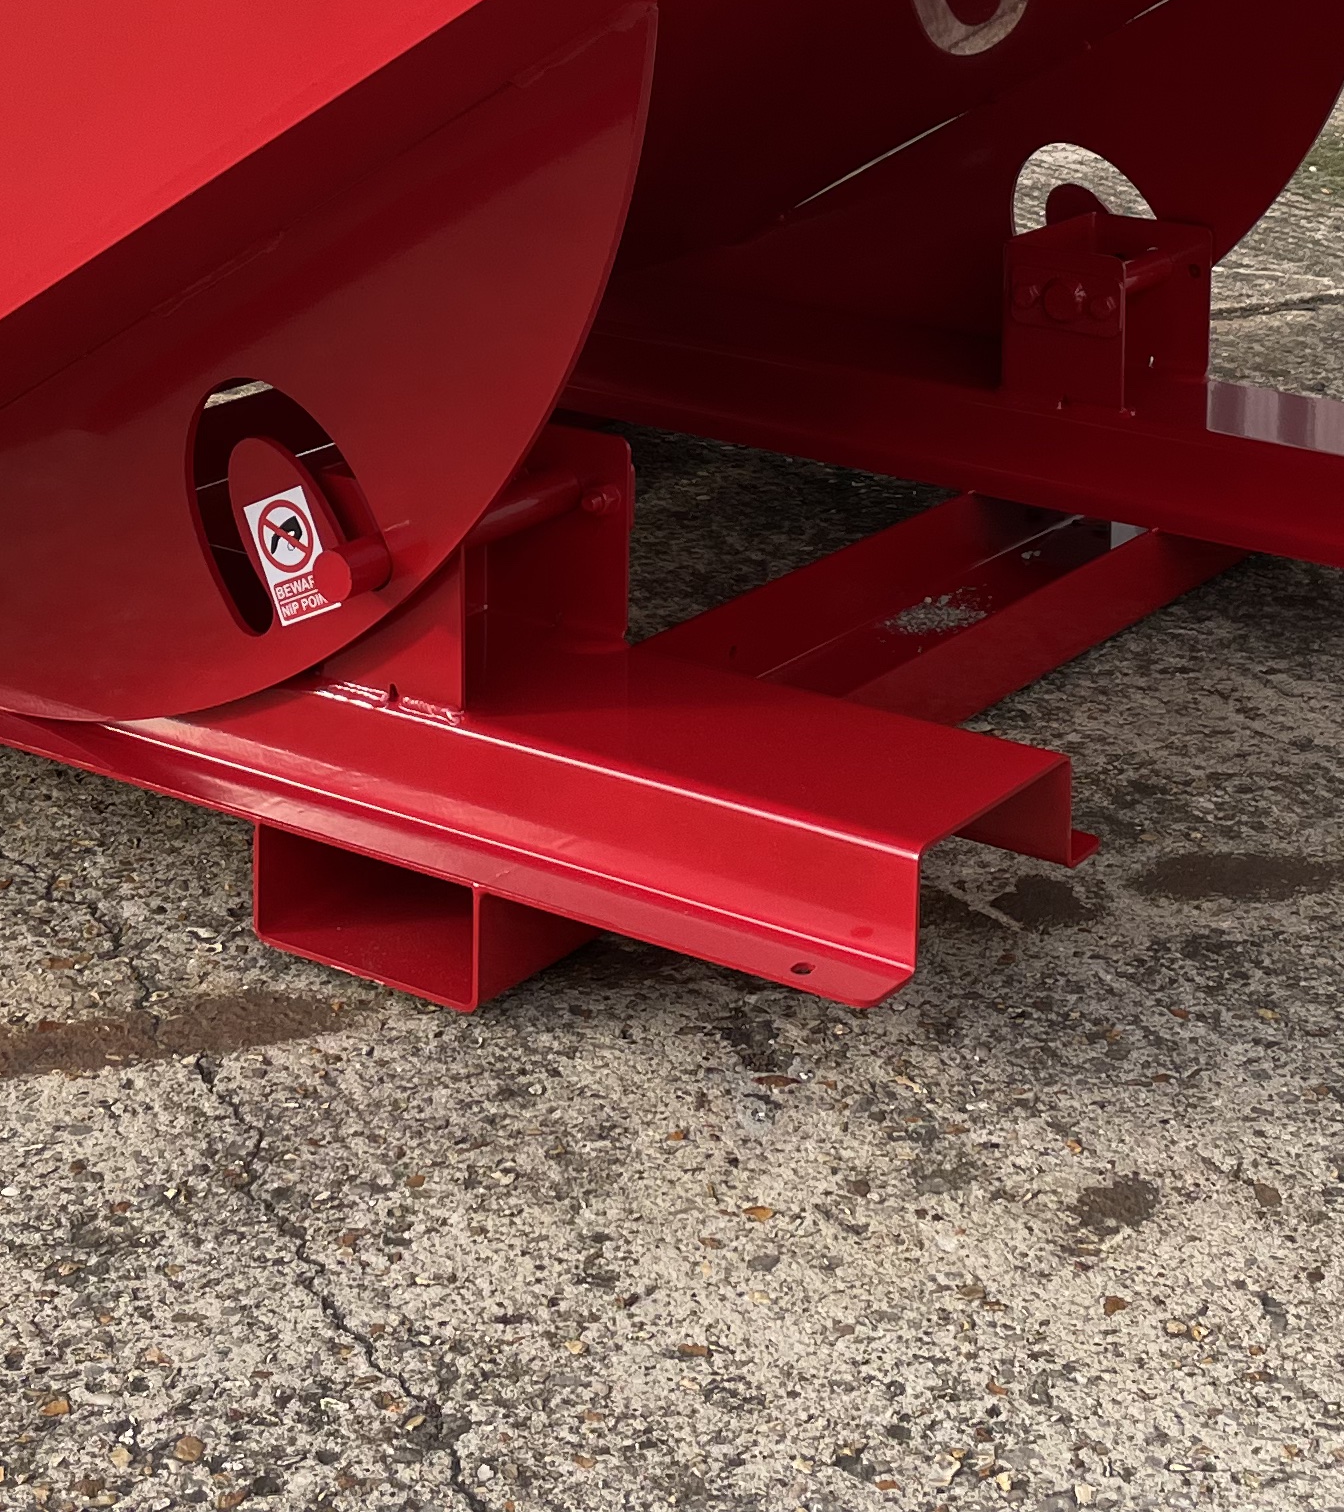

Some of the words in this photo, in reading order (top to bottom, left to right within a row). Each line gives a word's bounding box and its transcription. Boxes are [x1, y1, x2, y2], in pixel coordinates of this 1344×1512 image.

[276, 575, 315, 600] BEWAR
[281, 601, 299, 617] NIP
[301, 593, 328, 611] POIN
